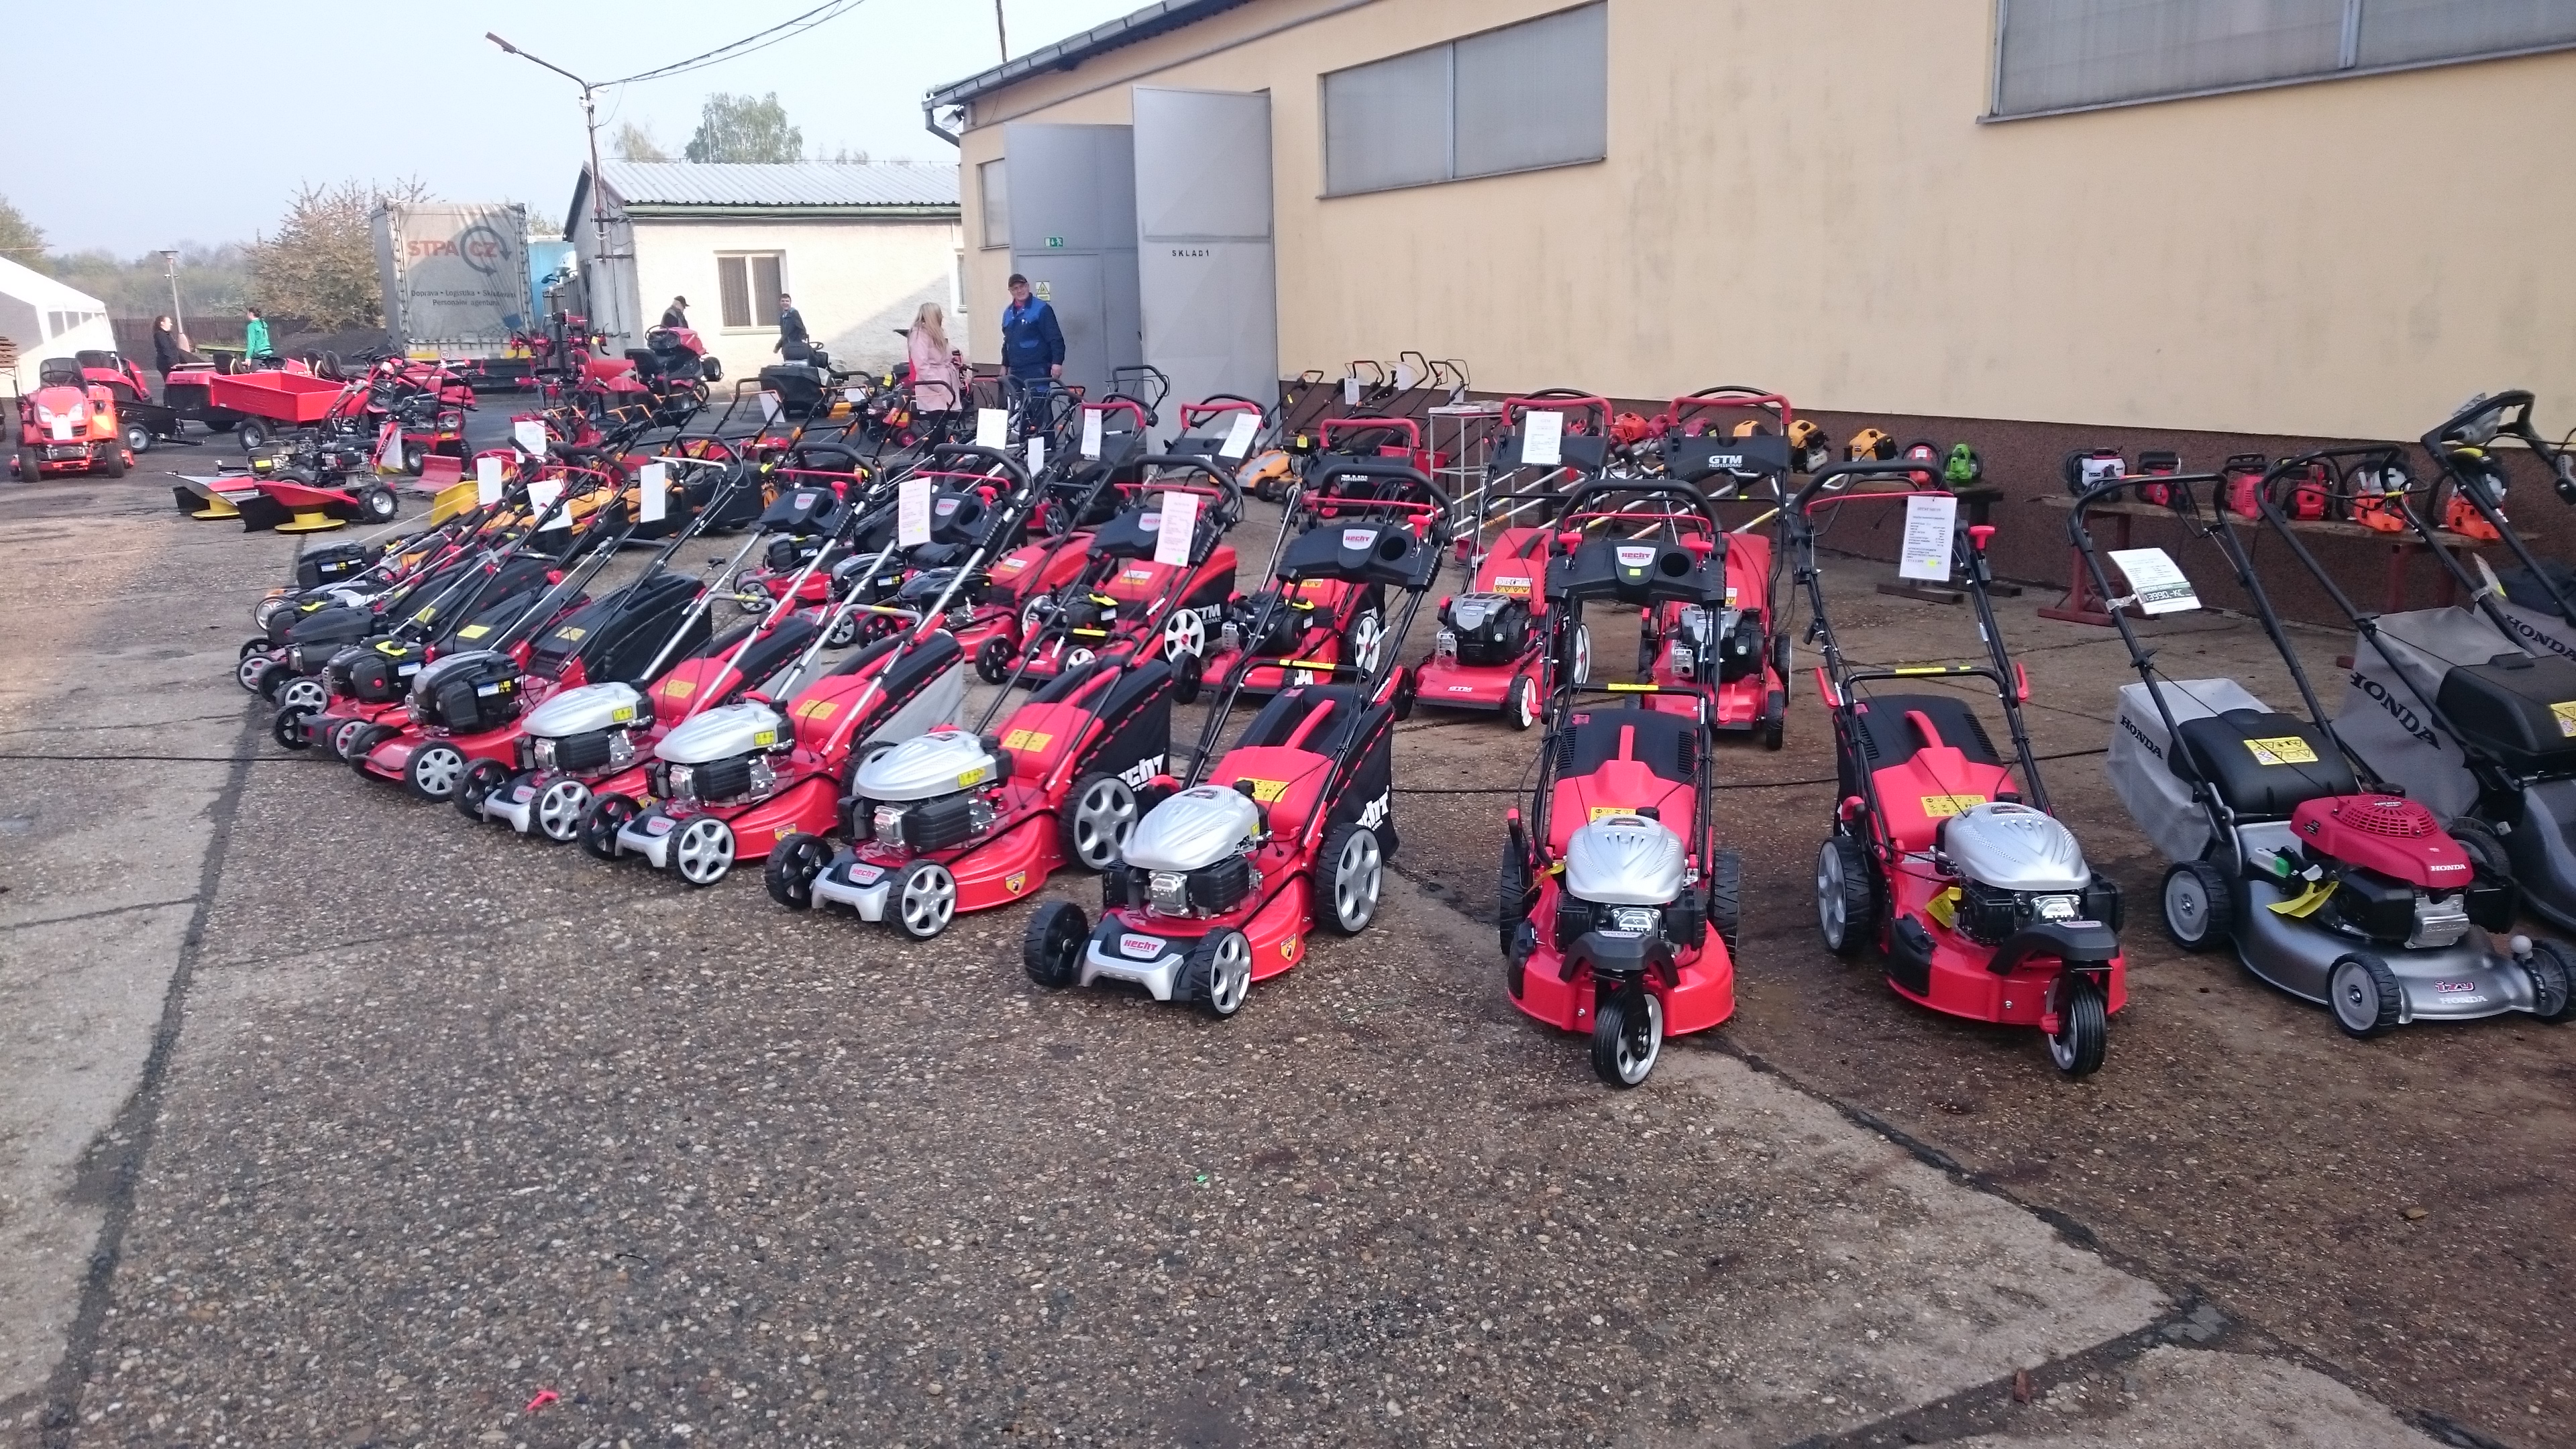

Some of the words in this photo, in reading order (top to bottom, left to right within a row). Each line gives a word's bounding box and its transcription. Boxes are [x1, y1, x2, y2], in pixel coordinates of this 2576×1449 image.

[407, 240, 460, 257] STPA
[470, 241, 497, 258] CZ
[411, 290, 439, 298] Doprava
[1709, 455, 1743, 464] GTM
[2350, 672, 2441, 750] HONDA
[2120, 715, 2163, 759] HONDA
[2434, 980, 2475, 994] izy
[2439, 995, 2489, 1004] HONDA
